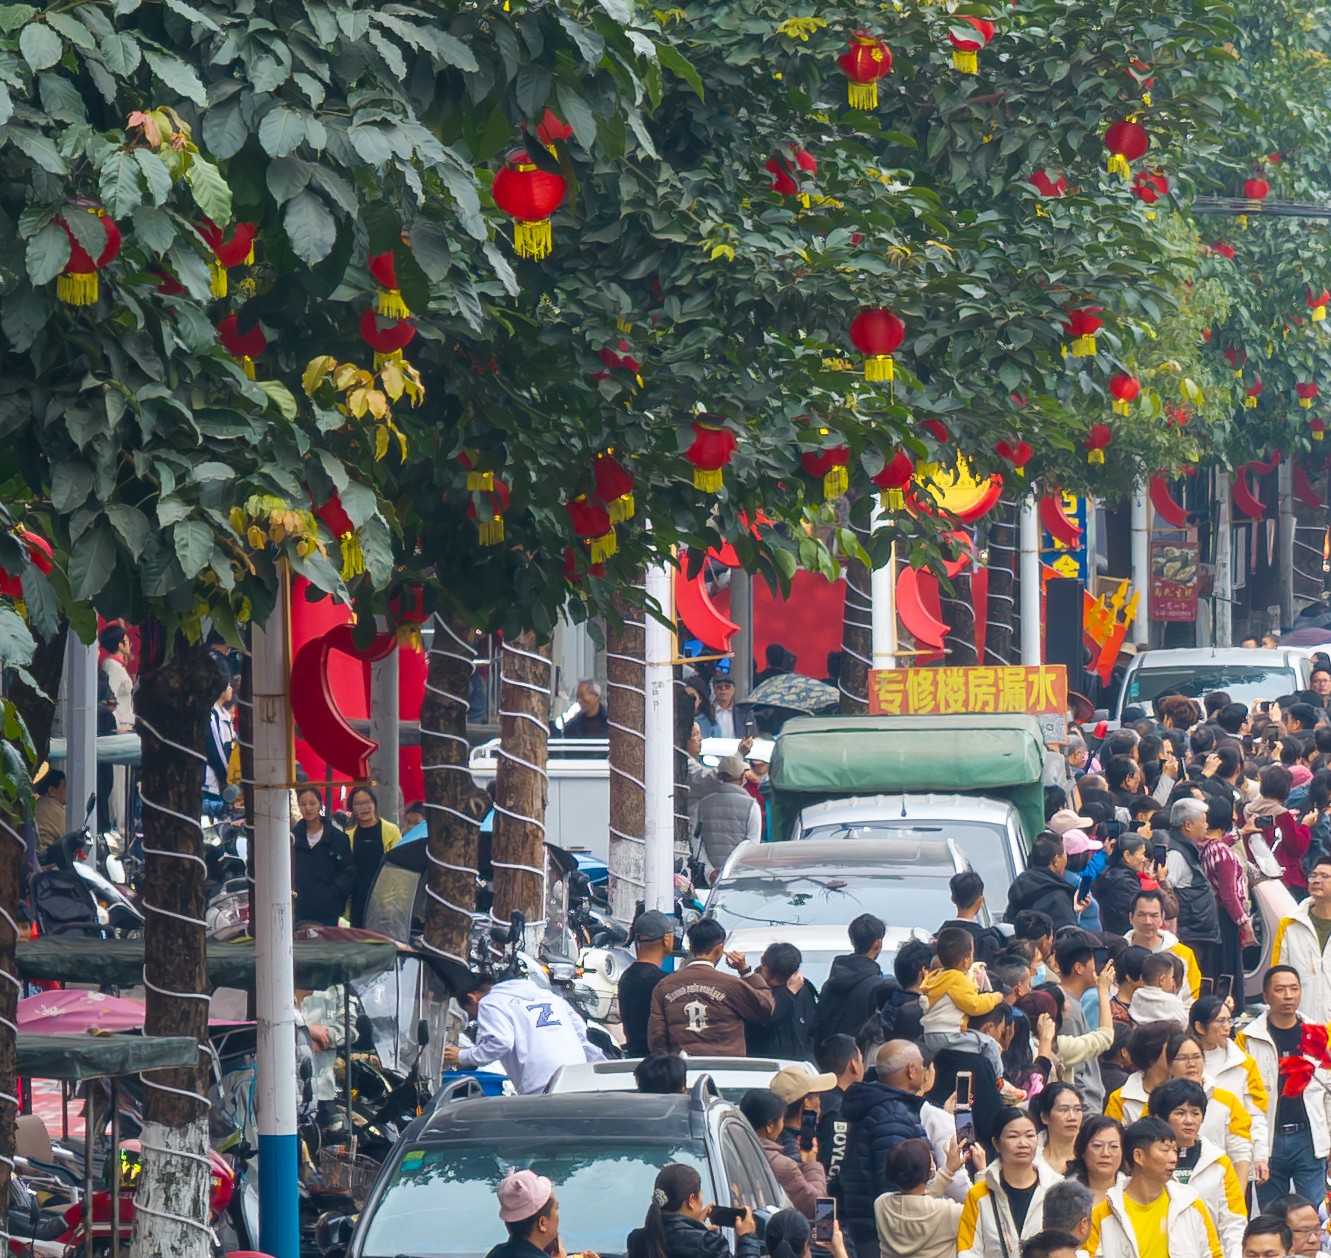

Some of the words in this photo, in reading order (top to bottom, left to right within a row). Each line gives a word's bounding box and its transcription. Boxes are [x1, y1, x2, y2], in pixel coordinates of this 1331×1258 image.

[874, 667, 1058, 715] 专修楼房漏水
[526, 1003, 562, 1028] Z
